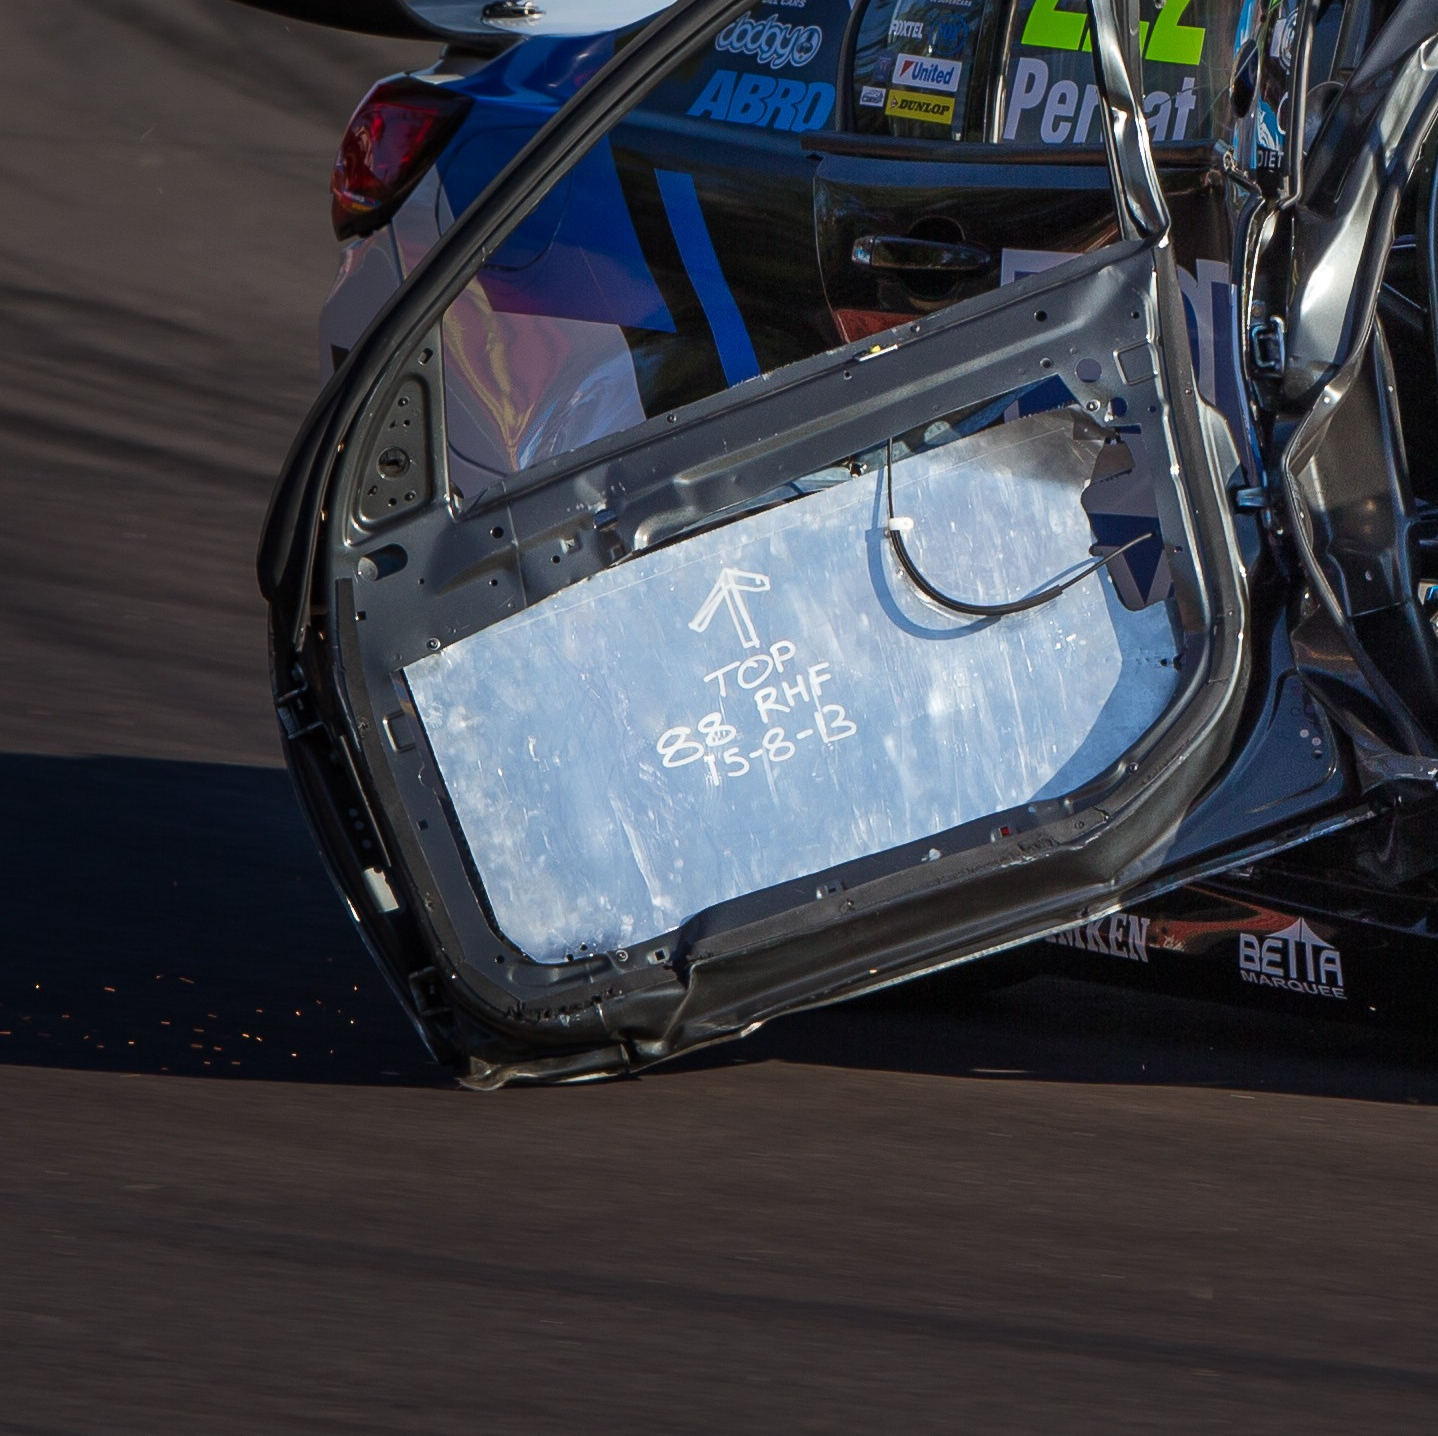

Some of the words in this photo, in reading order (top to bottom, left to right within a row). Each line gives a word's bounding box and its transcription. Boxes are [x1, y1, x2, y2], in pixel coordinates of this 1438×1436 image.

[889, 20, 923, 39] FOXTEL
[687, 69, 836, 132] ABRO
[912, 62, 954, 84] United
[1003, 57, 1196, 143] Perat
[898, 99, 951, 116] DUNLOP
[703, 640, 796, 697] TOP
[754, 661, 831, 723] RHF
[657, 712, 737, 768] 88
[1239, 917, 1344, 988] BETTA
[1239, 969, 1348, 1000] MARQUEE
